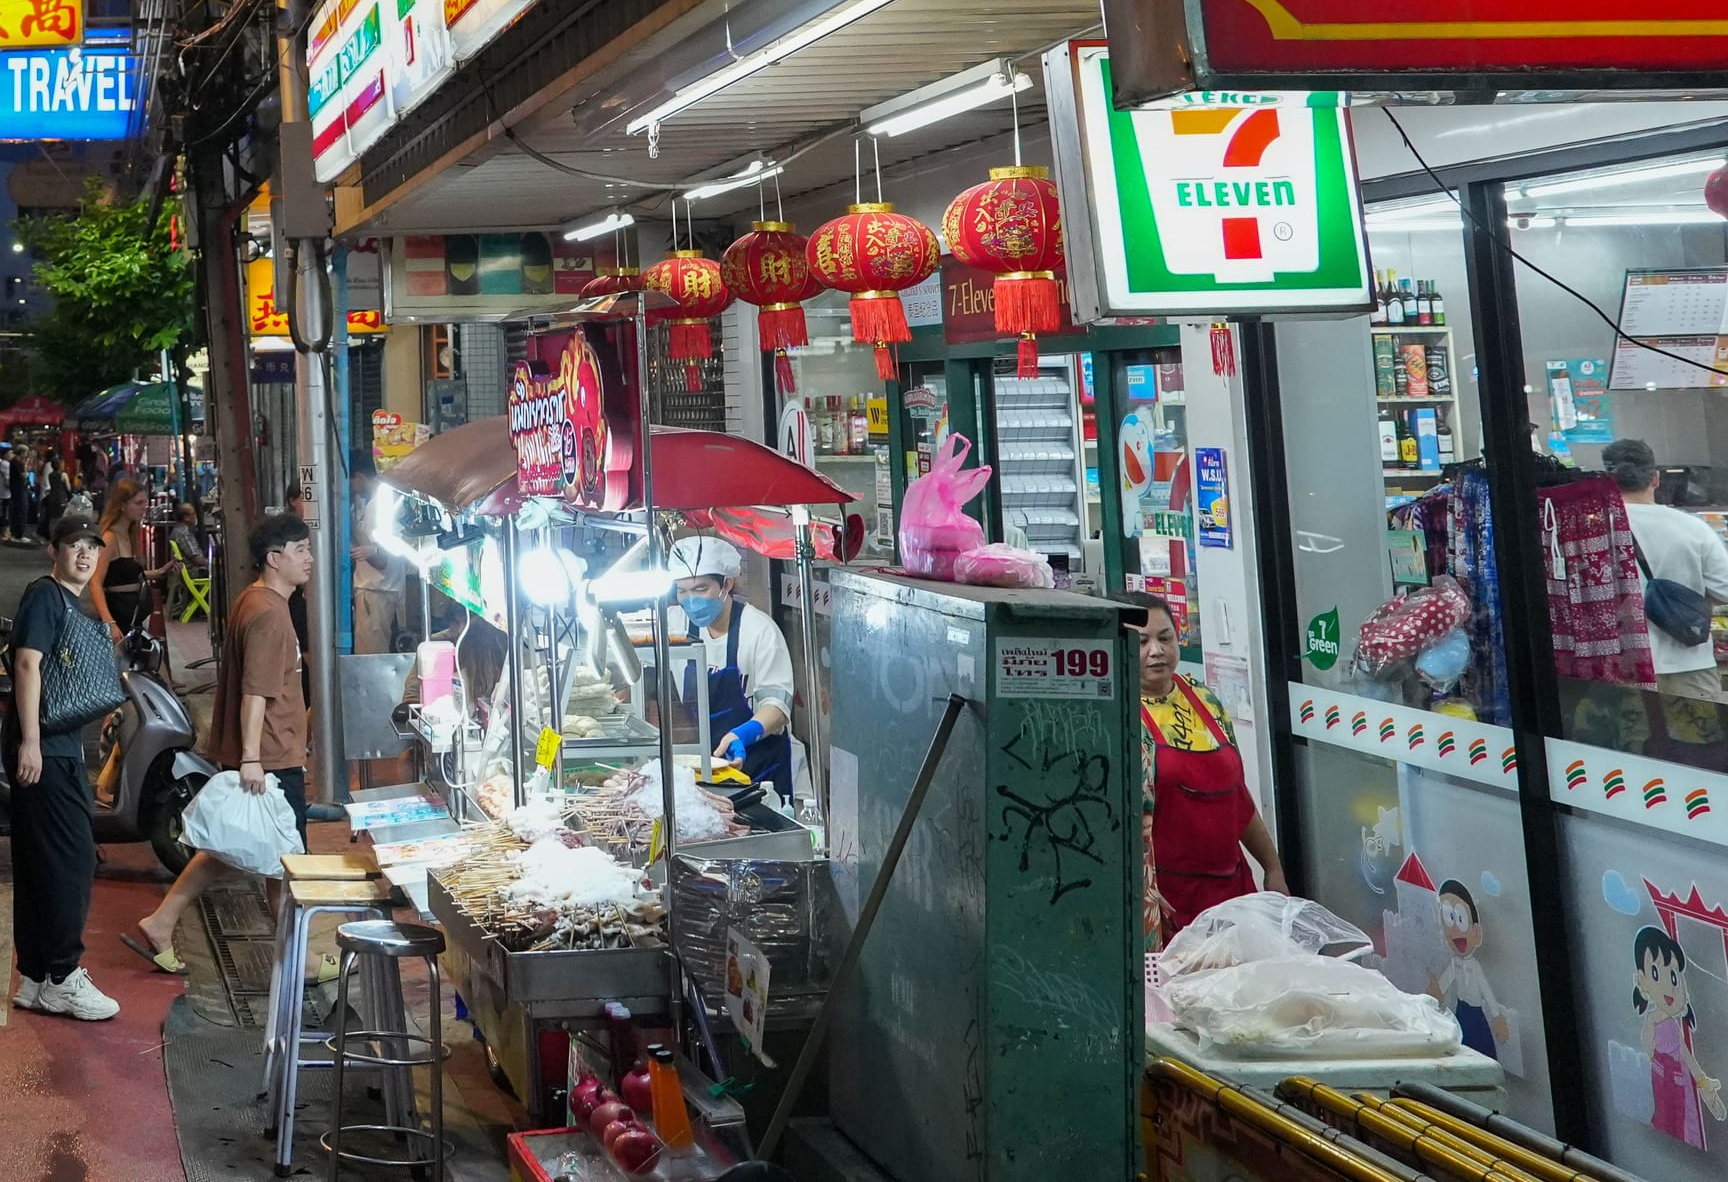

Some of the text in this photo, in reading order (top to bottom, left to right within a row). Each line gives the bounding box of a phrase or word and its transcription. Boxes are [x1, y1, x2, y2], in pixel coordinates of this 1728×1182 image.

[7, 55, 136, 113] TRAVEL
[948, 281, 995, 317] 7-Eleve
[1309, 638, 1338, 656] Green
[1050, 649, 1109, 678] 199
